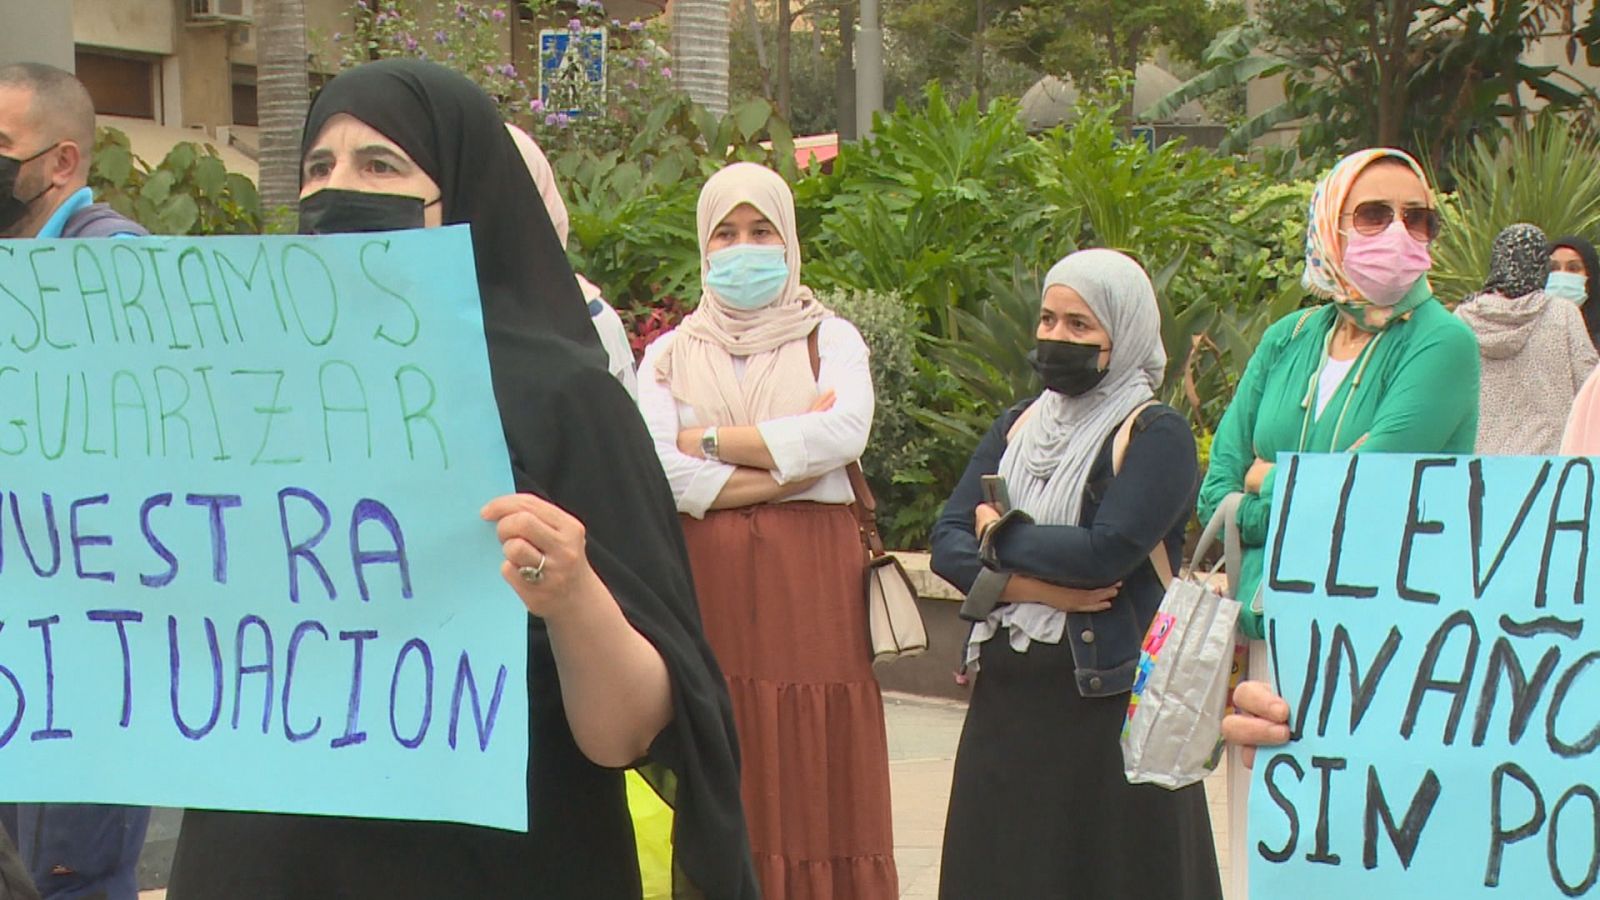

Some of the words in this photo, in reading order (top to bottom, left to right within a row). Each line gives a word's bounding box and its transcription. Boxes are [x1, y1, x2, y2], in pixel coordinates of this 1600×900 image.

[0, 486, 413, 603] UESTRA
[1268, 454, 1596, 608] LLEVA
[1268, 618, 1403, 743] UN
[1258, 753, 1442, 871] SIN
[1484, 762, 1600, 897] PO
